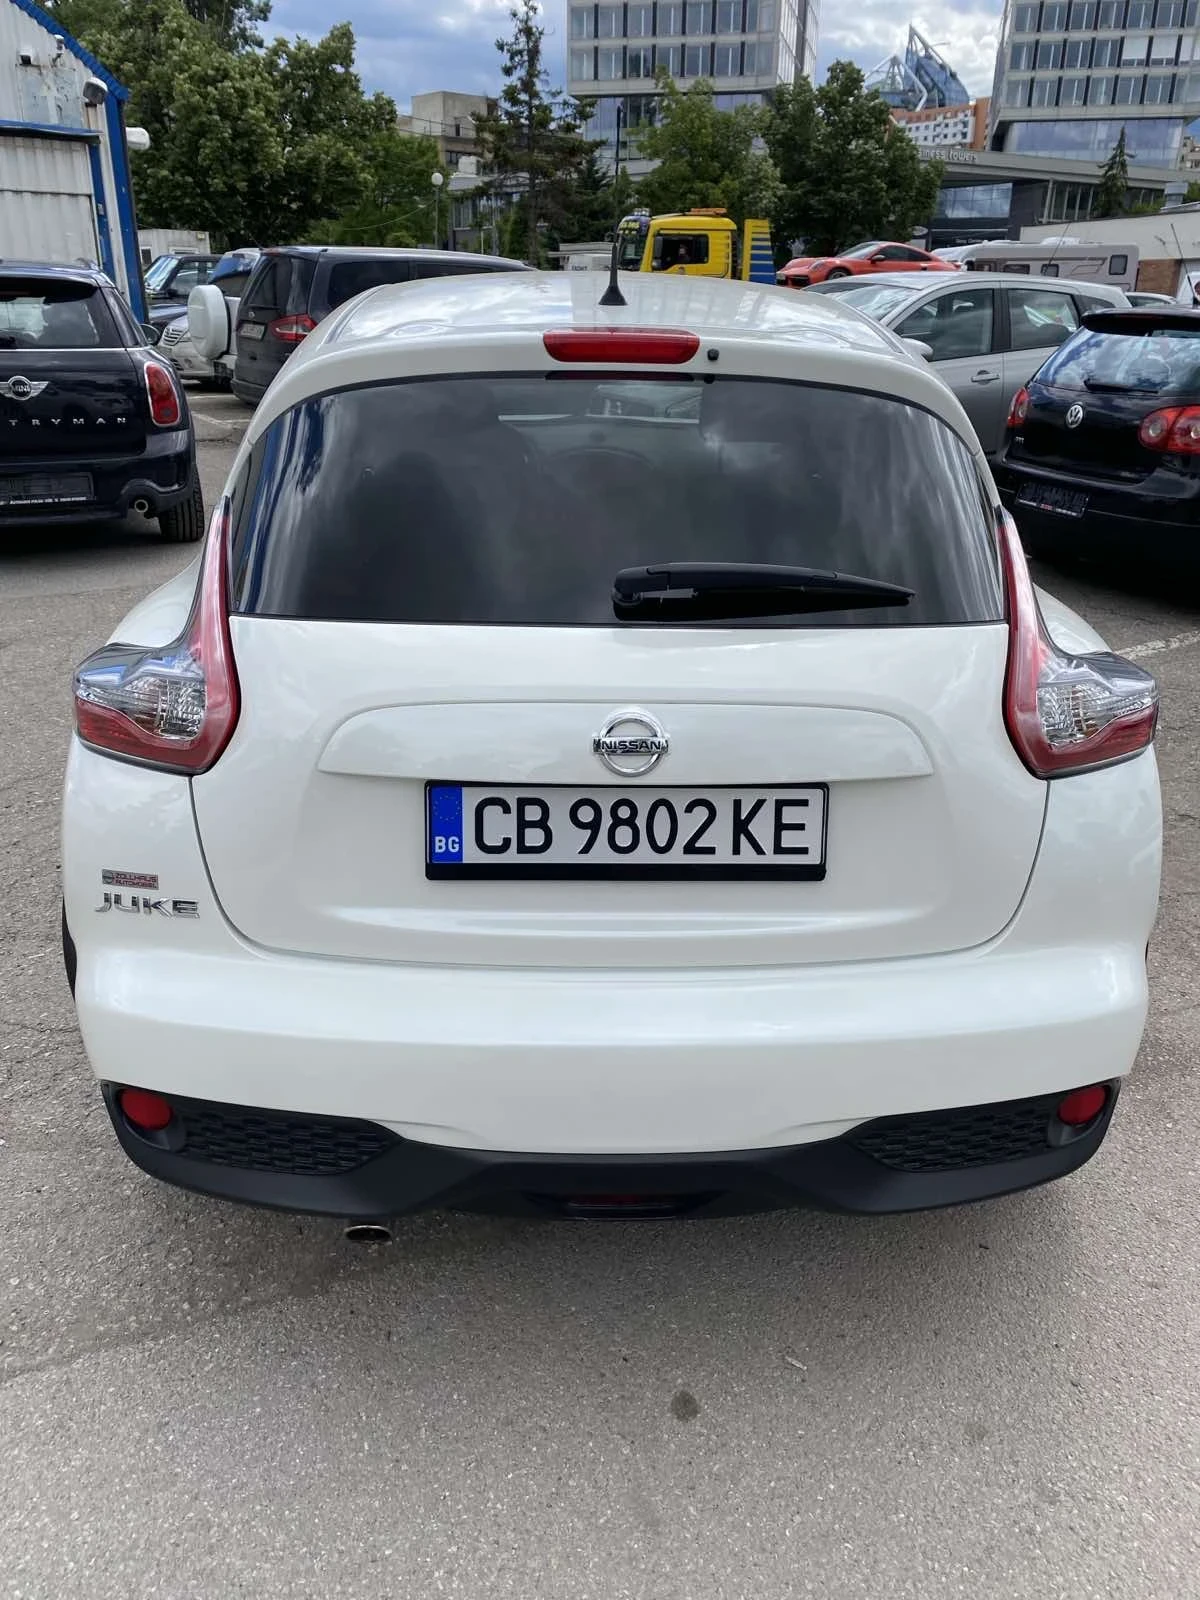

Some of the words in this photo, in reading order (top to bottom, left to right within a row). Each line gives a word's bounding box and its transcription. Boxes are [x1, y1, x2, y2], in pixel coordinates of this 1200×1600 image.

[601, 739, 661, 751] NISSAN
[474, 796, 553, 855] CB
[569, 797, 717, 856] 9802
[732, 798, 810, 856] KE
[434, 836, 459, 853] BG
[94, 892, 200, 918] JUKE
